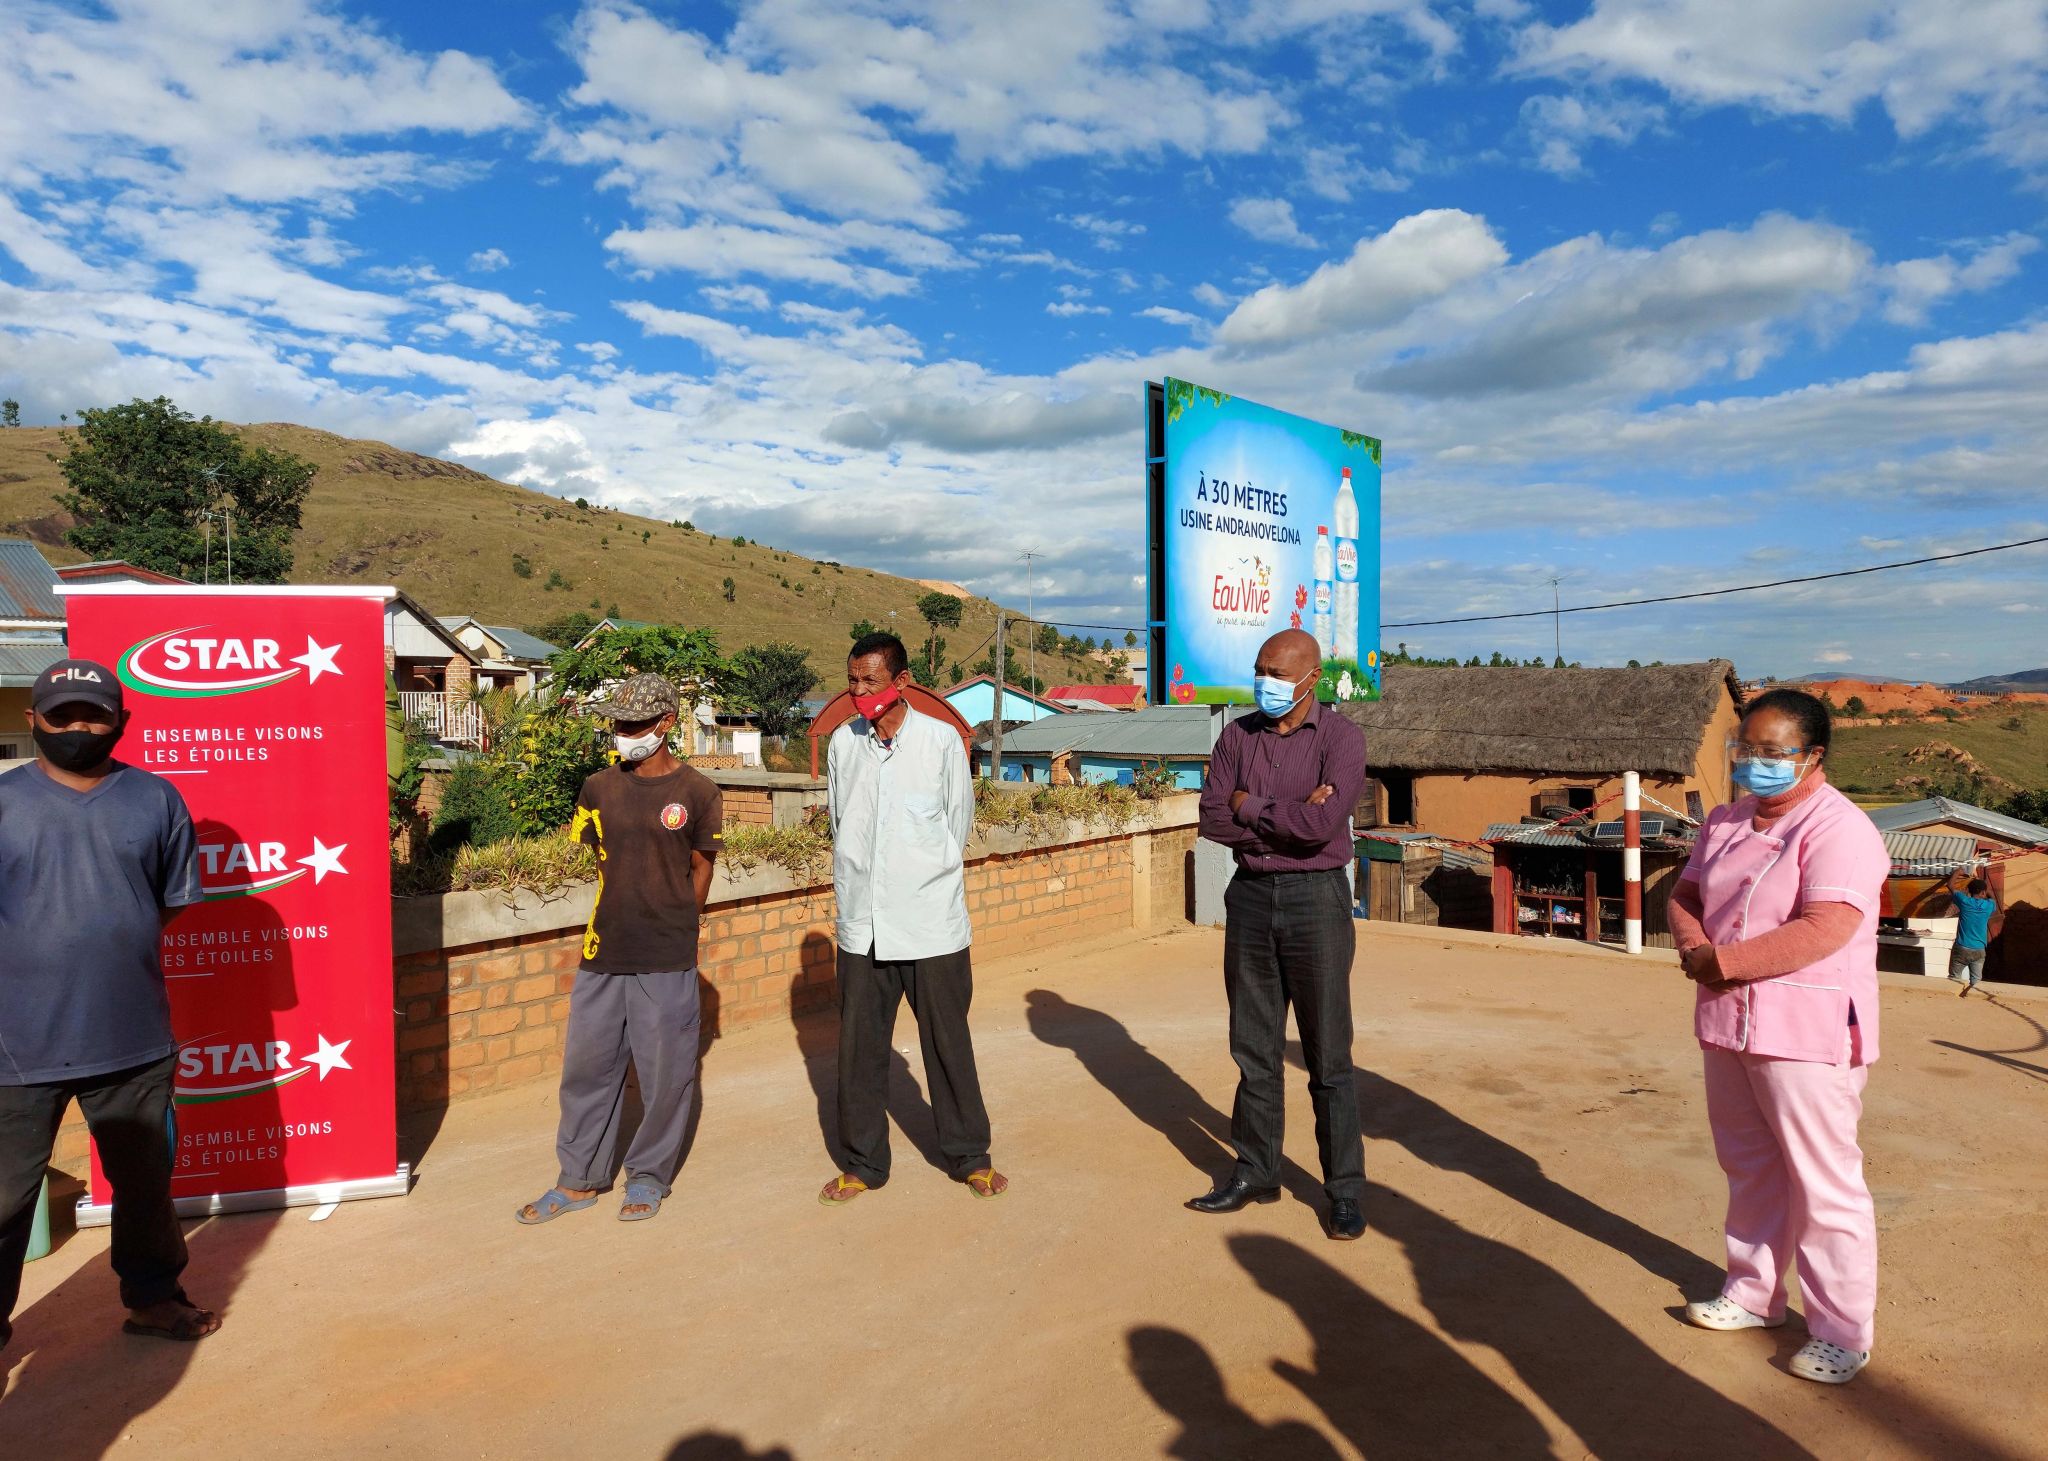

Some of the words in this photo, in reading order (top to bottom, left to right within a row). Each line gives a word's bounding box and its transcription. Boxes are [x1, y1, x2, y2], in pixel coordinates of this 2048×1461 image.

[1197, 470, 1207, 501] À
[1212, 479, 1229, 505] 30
[1234, 481, 1288, 517] MÈTRES
[1181, 508, 1213, 531] USINE
[1215, 515, 1301, 545] ANDRANOVELONA
[164, 638, 282, 671] STAR
[50, 668, 102, 683] FILA
[143, 728, 246, 743] ENSEMBLE
[255, 726, 323, 741] VISONS
[144, 749, 179, 763] LES
[189, 747, 268, 763] ÉTOILES
[198, 841, 288, 875] TAR
[164, 930, 251, 947] NSEMBLE
[261, 926, 329, 942] VISONS
[164, 954, 185, 967] ES
[196, 949, 273, 966] ÉTOILES
[178, 1040, 293, 1078] STAR
[177, 1128, 256, 1148] SEMBLE
[266, 1121, 332, 1139] VISONS
[202, 1146, 278, 1165] ÉTOILES
